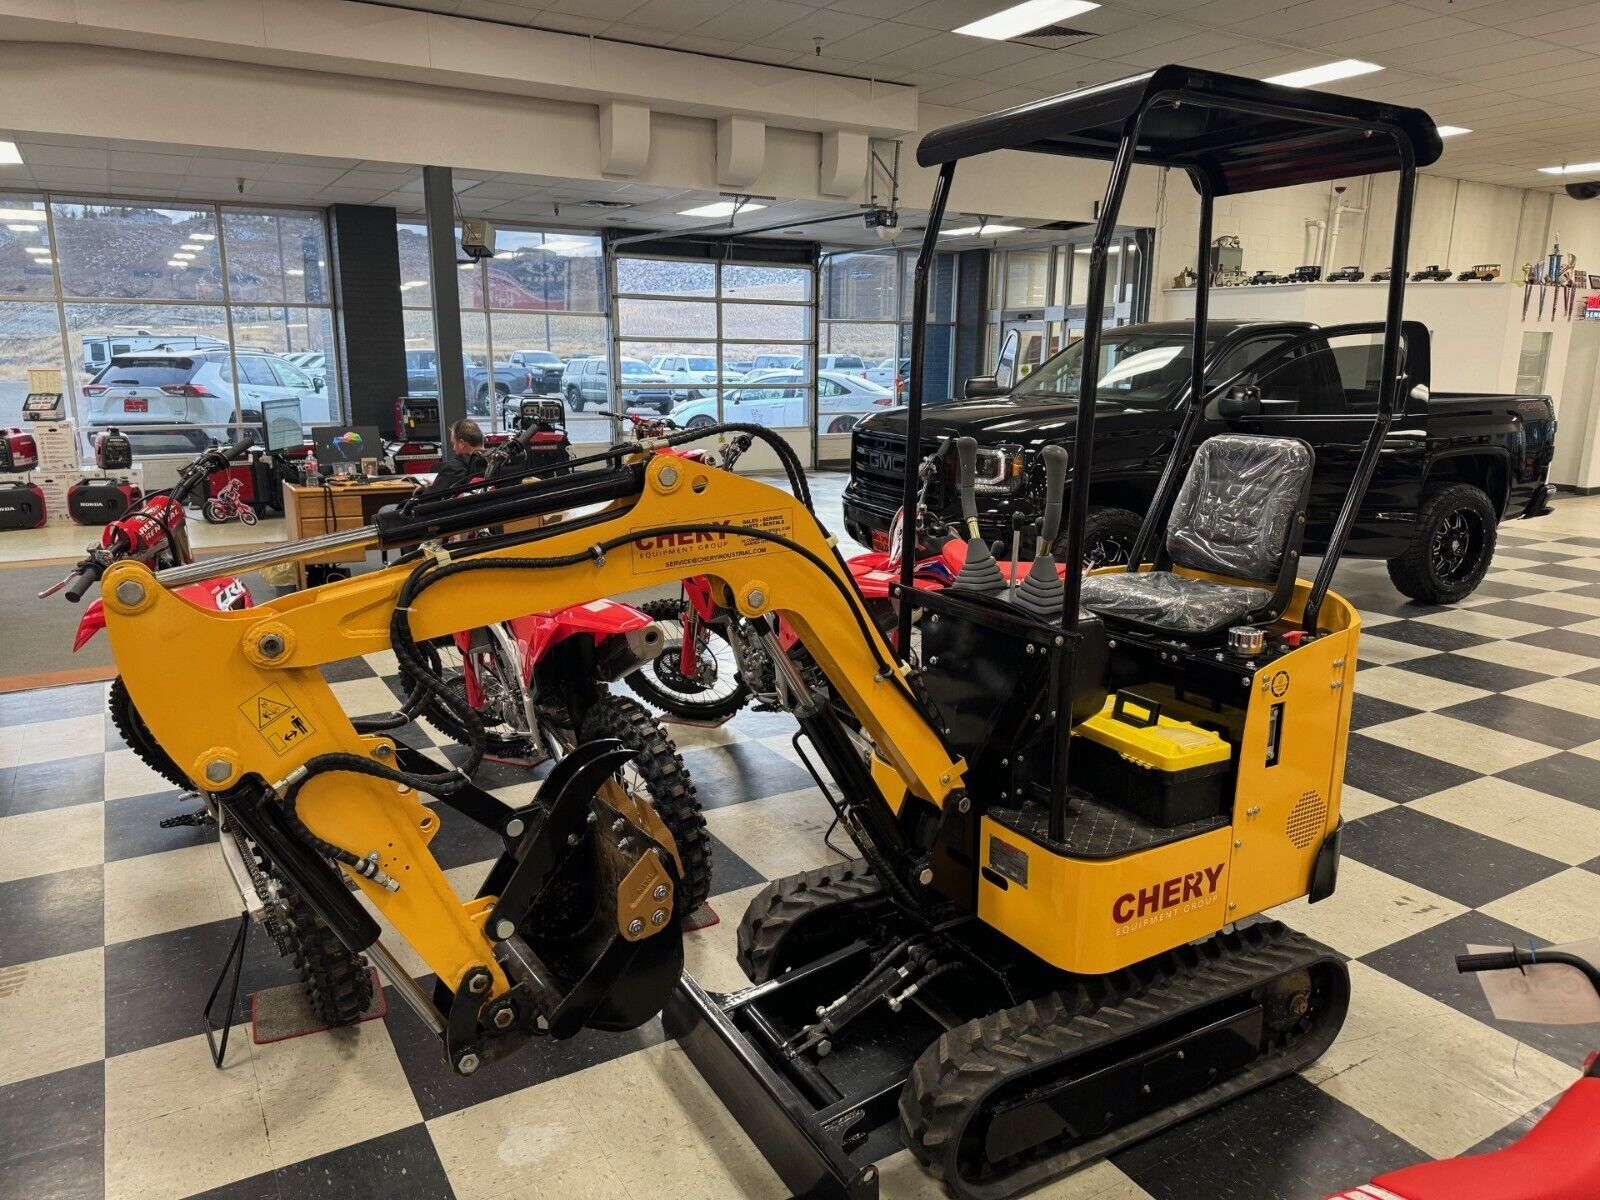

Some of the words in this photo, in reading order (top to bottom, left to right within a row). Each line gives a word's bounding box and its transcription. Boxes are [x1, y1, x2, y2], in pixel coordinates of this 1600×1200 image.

[869, 452, 905, 472] GMC
[138, 504, 176, 535] RENTHL
[640, 547, 693, 559] EQUIPMENT
[700, 542, 729, 550] GROUP
[665, 547, 767, 567] SERVICE@CHERYINDUSTRIAL.COM
[1112, 862, 1226, 924] CHERY
[1116, 909, 1179, 937] EQUIPMENT
[1183, 895, 1218, 913] GROUP
